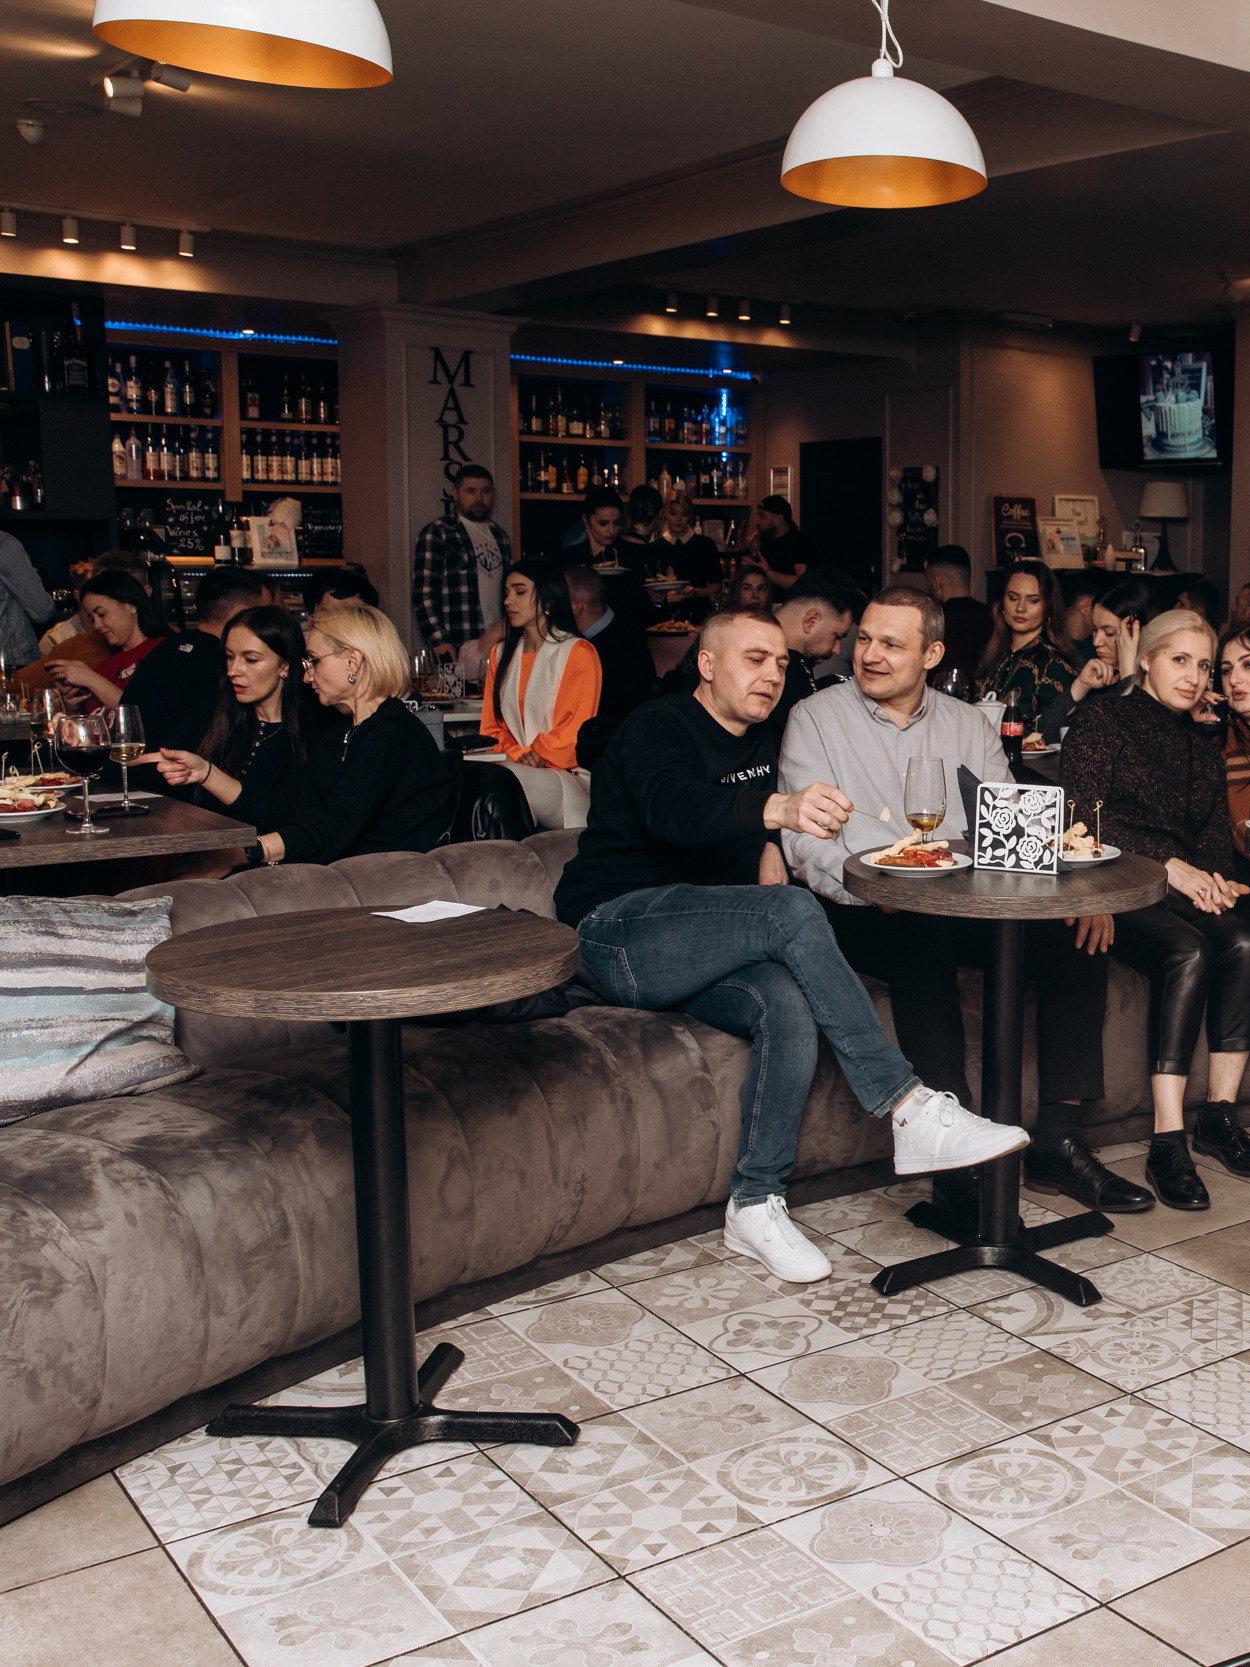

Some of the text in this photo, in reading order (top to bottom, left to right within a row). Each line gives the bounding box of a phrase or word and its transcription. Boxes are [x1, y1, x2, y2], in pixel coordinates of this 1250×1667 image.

[165, 498, 203, 513] Special
[179, 512, 206, 525] offer
[165, 525, 199, 537] Wines
